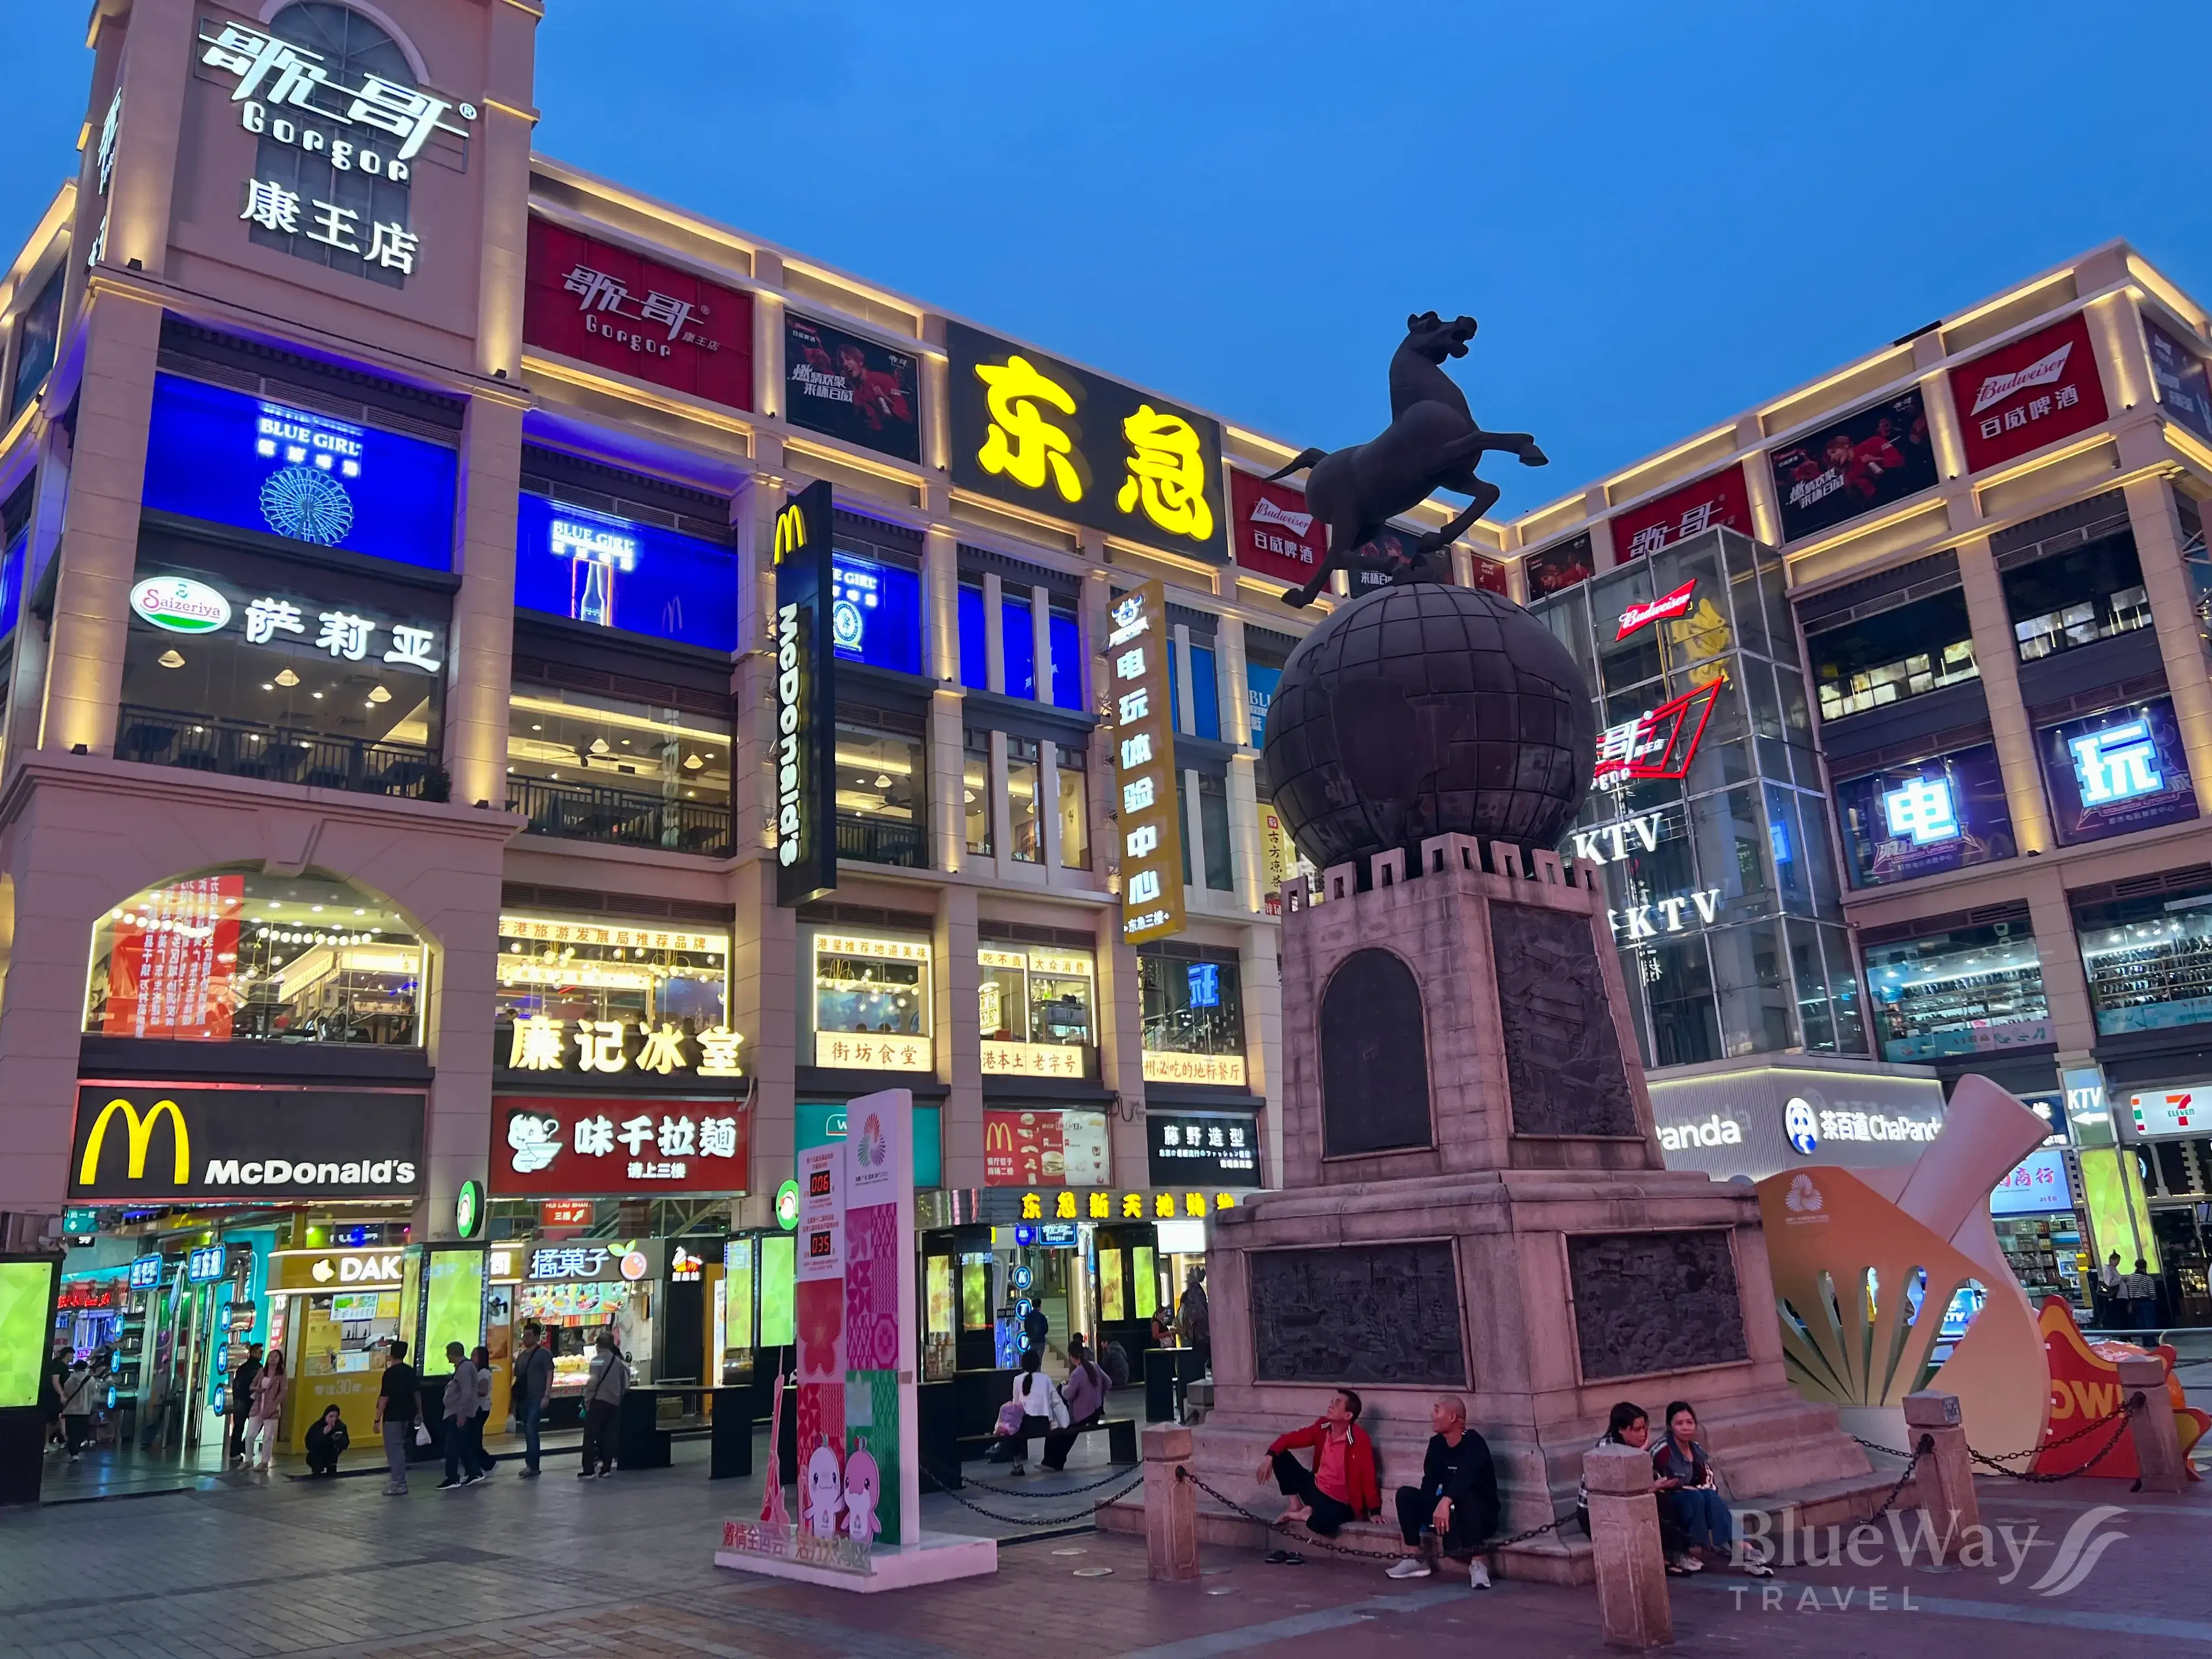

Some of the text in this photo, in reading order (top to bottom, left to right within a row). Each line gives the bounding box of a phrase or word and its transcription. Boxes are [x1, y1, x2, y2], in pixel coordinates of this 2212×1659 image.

[240, 179, 419, 275] 康王店
[681, 332, 720, 352] 康王店
[1974, 357, 2069, 403] Budweiser
[1979, 384, 2079, 439] 百威啤酒
[261, 419, 358, 456] BLUE GIRL
[975, 355, 1213, 541] 东急
[1254, 500, 1309, 529] Budweiser
[553, 521, 632, 551] BLUE GIRL
[1254, 529, 1313, 564] 百威啤酒
[844, 572, 876, 589] GIRL
[143, 589, 220, 617] Saizeriya
[1618, 592, 1691, 629] Budweiser
[245, 597, 442, 672] 萨莉亚
[778, 602, 801, 867] McDonald's
[1116, 645, 1160, 906] 电玩体验中心
[2075, 725, 2157, 802] 玩
[1886, 780, 1955, 839] 电
[1572, 812, 1663, 866] KTV
[1128, 910, 1164, 933] 东急三楼
[1626, 888, 1720, 940] KTV
[817, 938, 927, 959] 港星推荐地道美味
[983, 953, 1021, 967] 吃不贵
[1035, 958, 1084, 974] 大众消费
[509, 1015, 744, 1077] 廉记冰室
[831, 1042, 917, 1065] 街坊食堂
[983, 1049, 1076, 1073] 港本土 老字号
[1144, 1060, 1239, 1081] 州必吃的地标餐厅
[2067, 1086, 2102, 1110] KTV
[1164, 1125, 1246, 1147] 藤野造型
[1819, 1110, 1942, 1142] 茶百道 ChaPand
[204, 1159, 415, 1185] McDonald's
[811, 1174, 829, 1193] 006
[1020, 1191, 1235, 1219] 东急新天地购物
[812, 1235, 830, 1255] 035
[723, 1521, 785, 1555] 激情全运会
